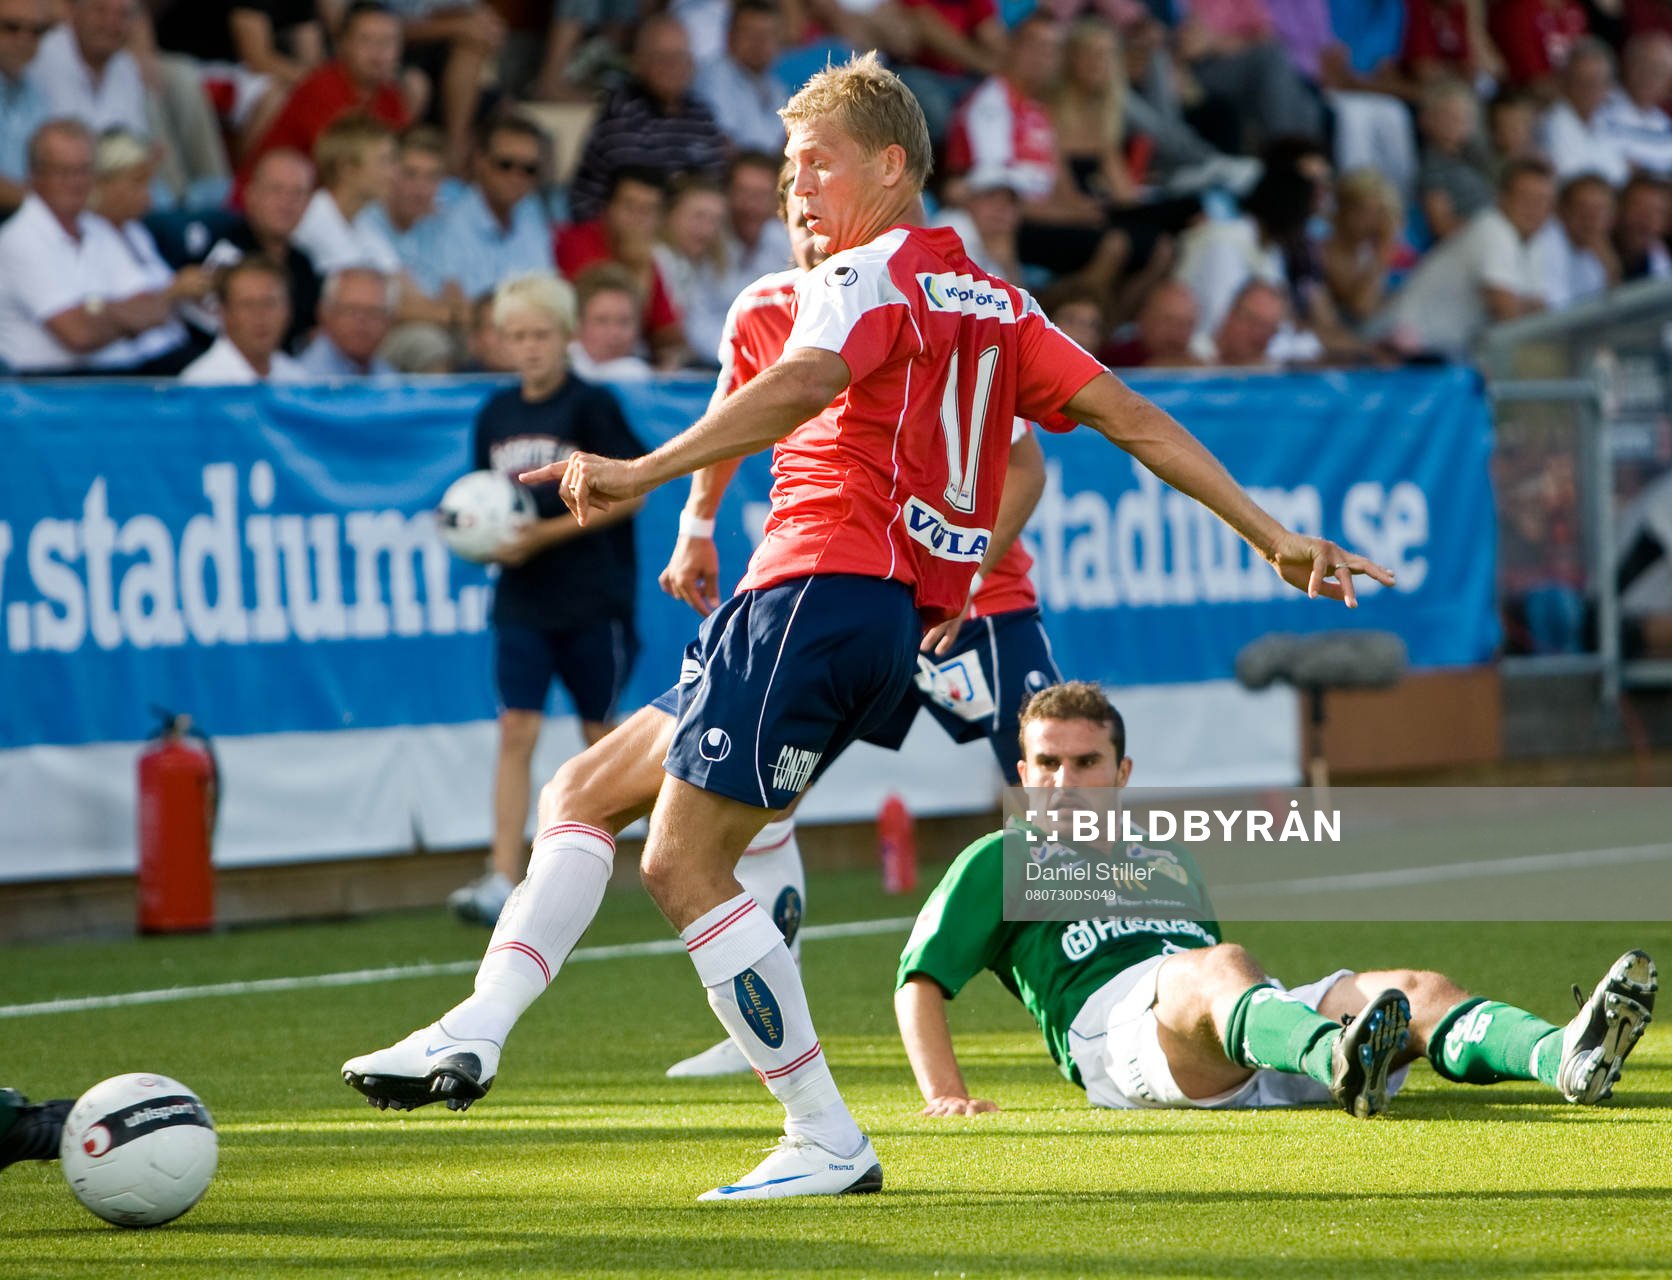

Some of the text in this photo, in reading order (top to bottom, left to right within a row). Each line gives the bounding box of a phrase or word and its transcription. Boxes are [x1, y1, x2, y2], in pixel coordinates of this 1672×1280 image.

[0, 462, 495, 653] .stadium.
[741, 973, 780, 1040] Santa Maria
